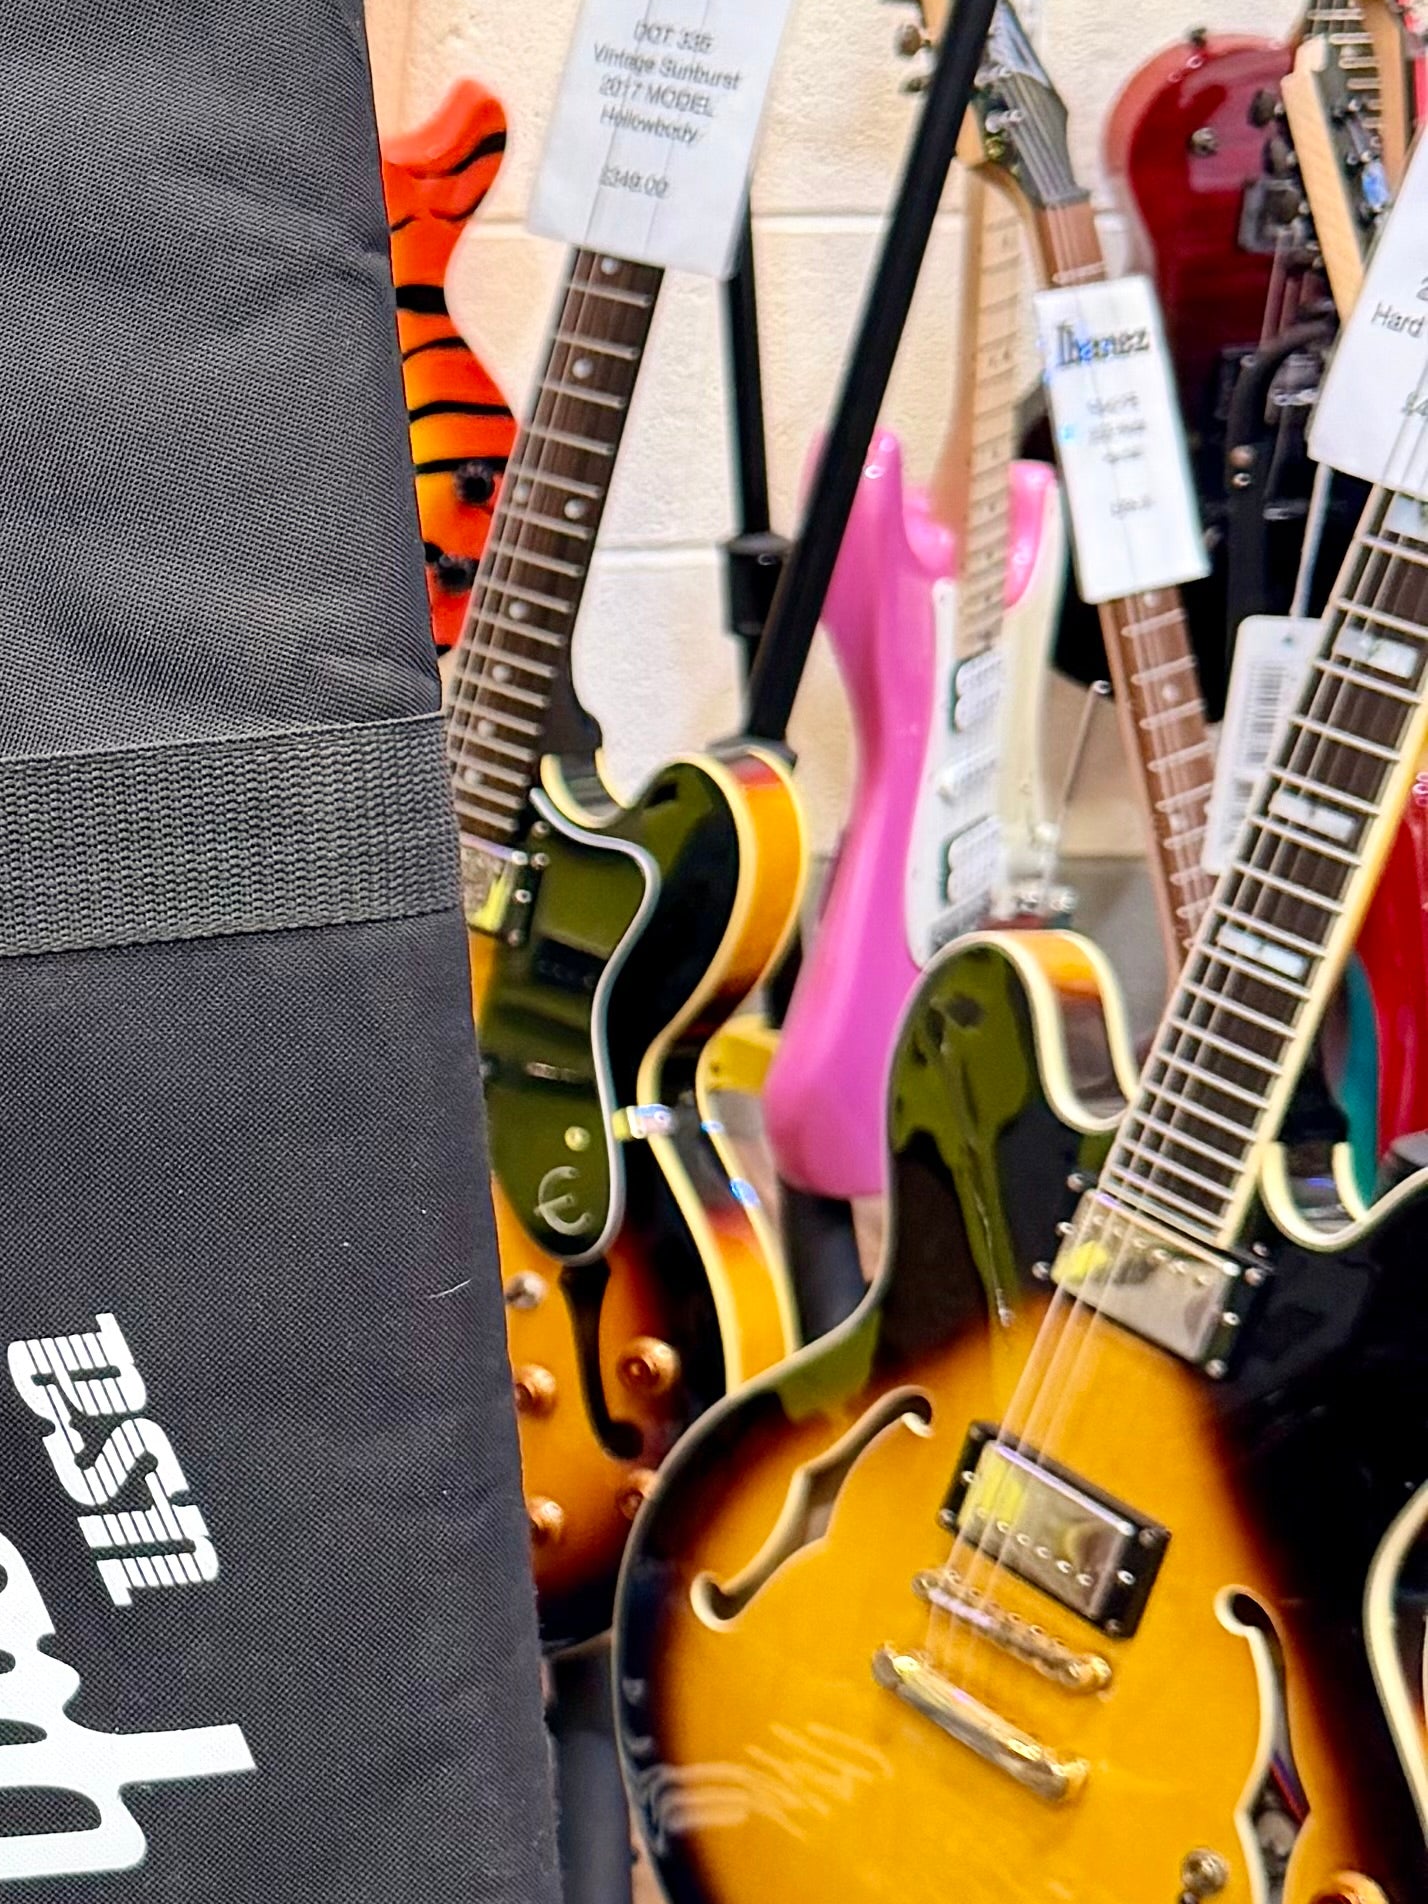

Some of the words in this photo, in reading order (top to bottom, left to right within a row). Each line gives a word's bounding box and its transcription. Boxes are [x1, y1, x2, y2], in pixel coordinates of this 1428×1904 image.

[634, 23, 674, 46] DOT
[593, 43, 656, 75] Vintage
[660, 56, 742, 90] Sunburst
[644, 84, 715, 118] MODEL
[600, 105, 699, 144] Hollowbody
[1371, 302, 1425, 339] Hard
[7, 1312, 219, 1607] USA
